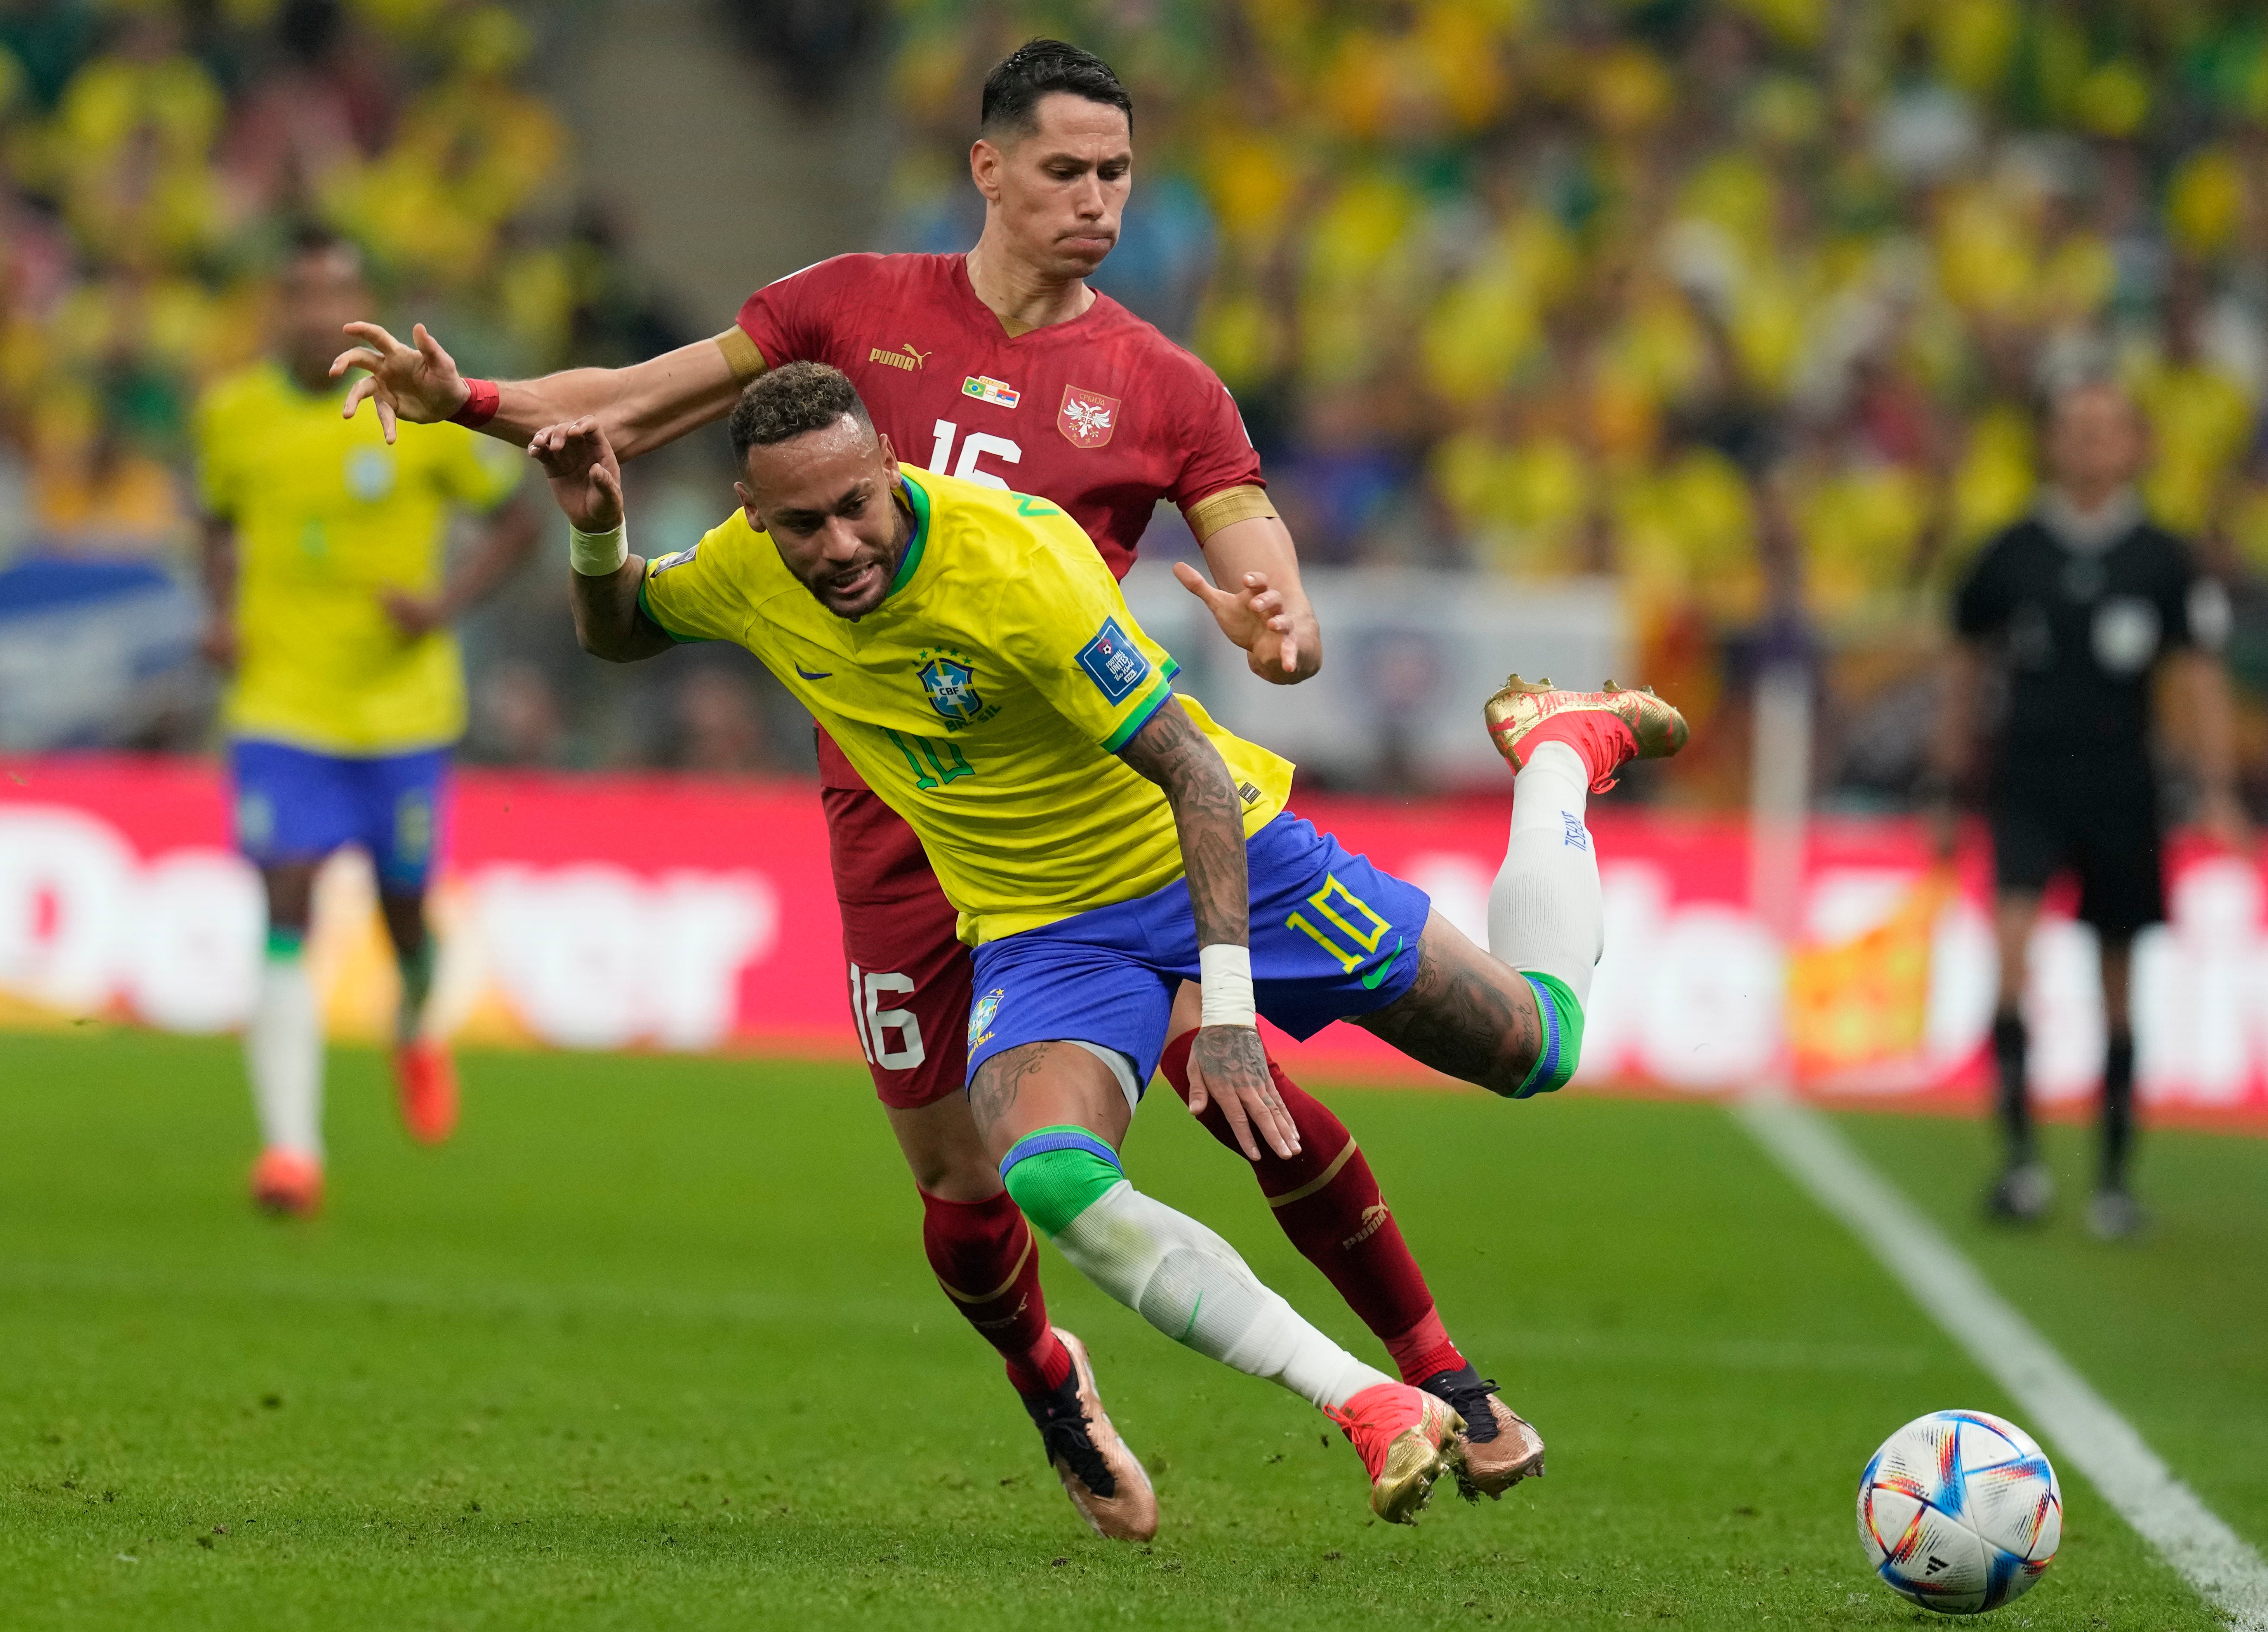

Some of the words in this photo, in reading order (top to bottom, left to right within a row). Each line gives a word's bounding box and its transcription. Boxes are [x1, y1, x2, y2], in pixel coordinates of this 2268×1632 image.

[869, 348, 916, 371] PUMA
[1105, 649, 1124, 668] FOOTBALL
[1109, 653, 1129, 675] UNITES
[1114, 672, 1123, 681] the
[1122, 658, 1135, 675] World
[1126, 672, 1134, 680] FIFA
[939, 687, 959, 695] CBF
[877, 725, 976, 790] 10
[1561, 811, 1586, 851] BRASIL
[1284, 871, 1392, 974] 10
[850, 962, 926, 1070] 16
[975, 1011, 986, 1025] CBF
[1342, 1209, 1387, 1251] PUMA
